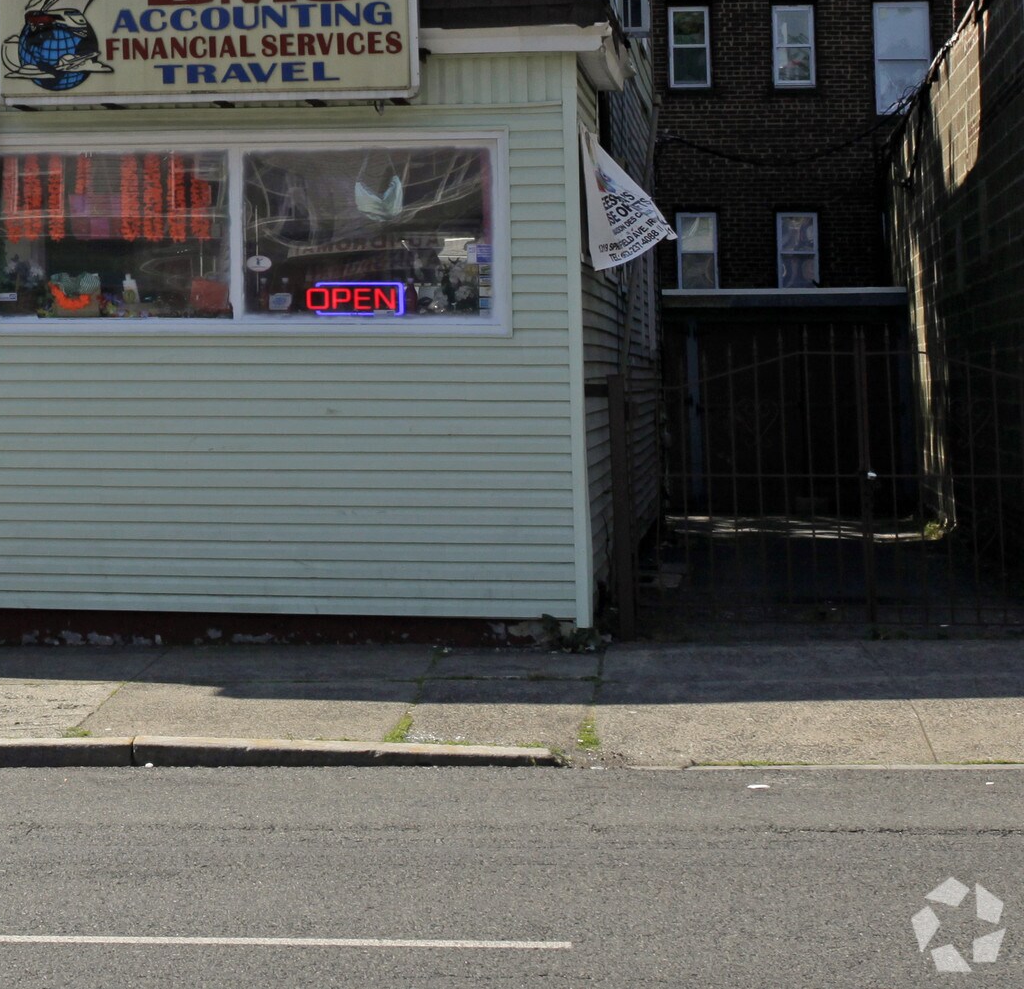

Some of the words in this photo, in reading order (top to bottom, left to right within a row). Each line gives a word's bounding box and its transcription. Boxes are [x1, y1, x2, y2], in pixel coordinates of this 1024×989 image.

[112, 1, 393, 33] ACCOUNTING
[105, 34, 255, 61] FINANCIAL
[261, 31, 403, 58] SERVICES
[154, 61, 340, 85] TRAVEL
[306, 288, 396, 309] OPEN
